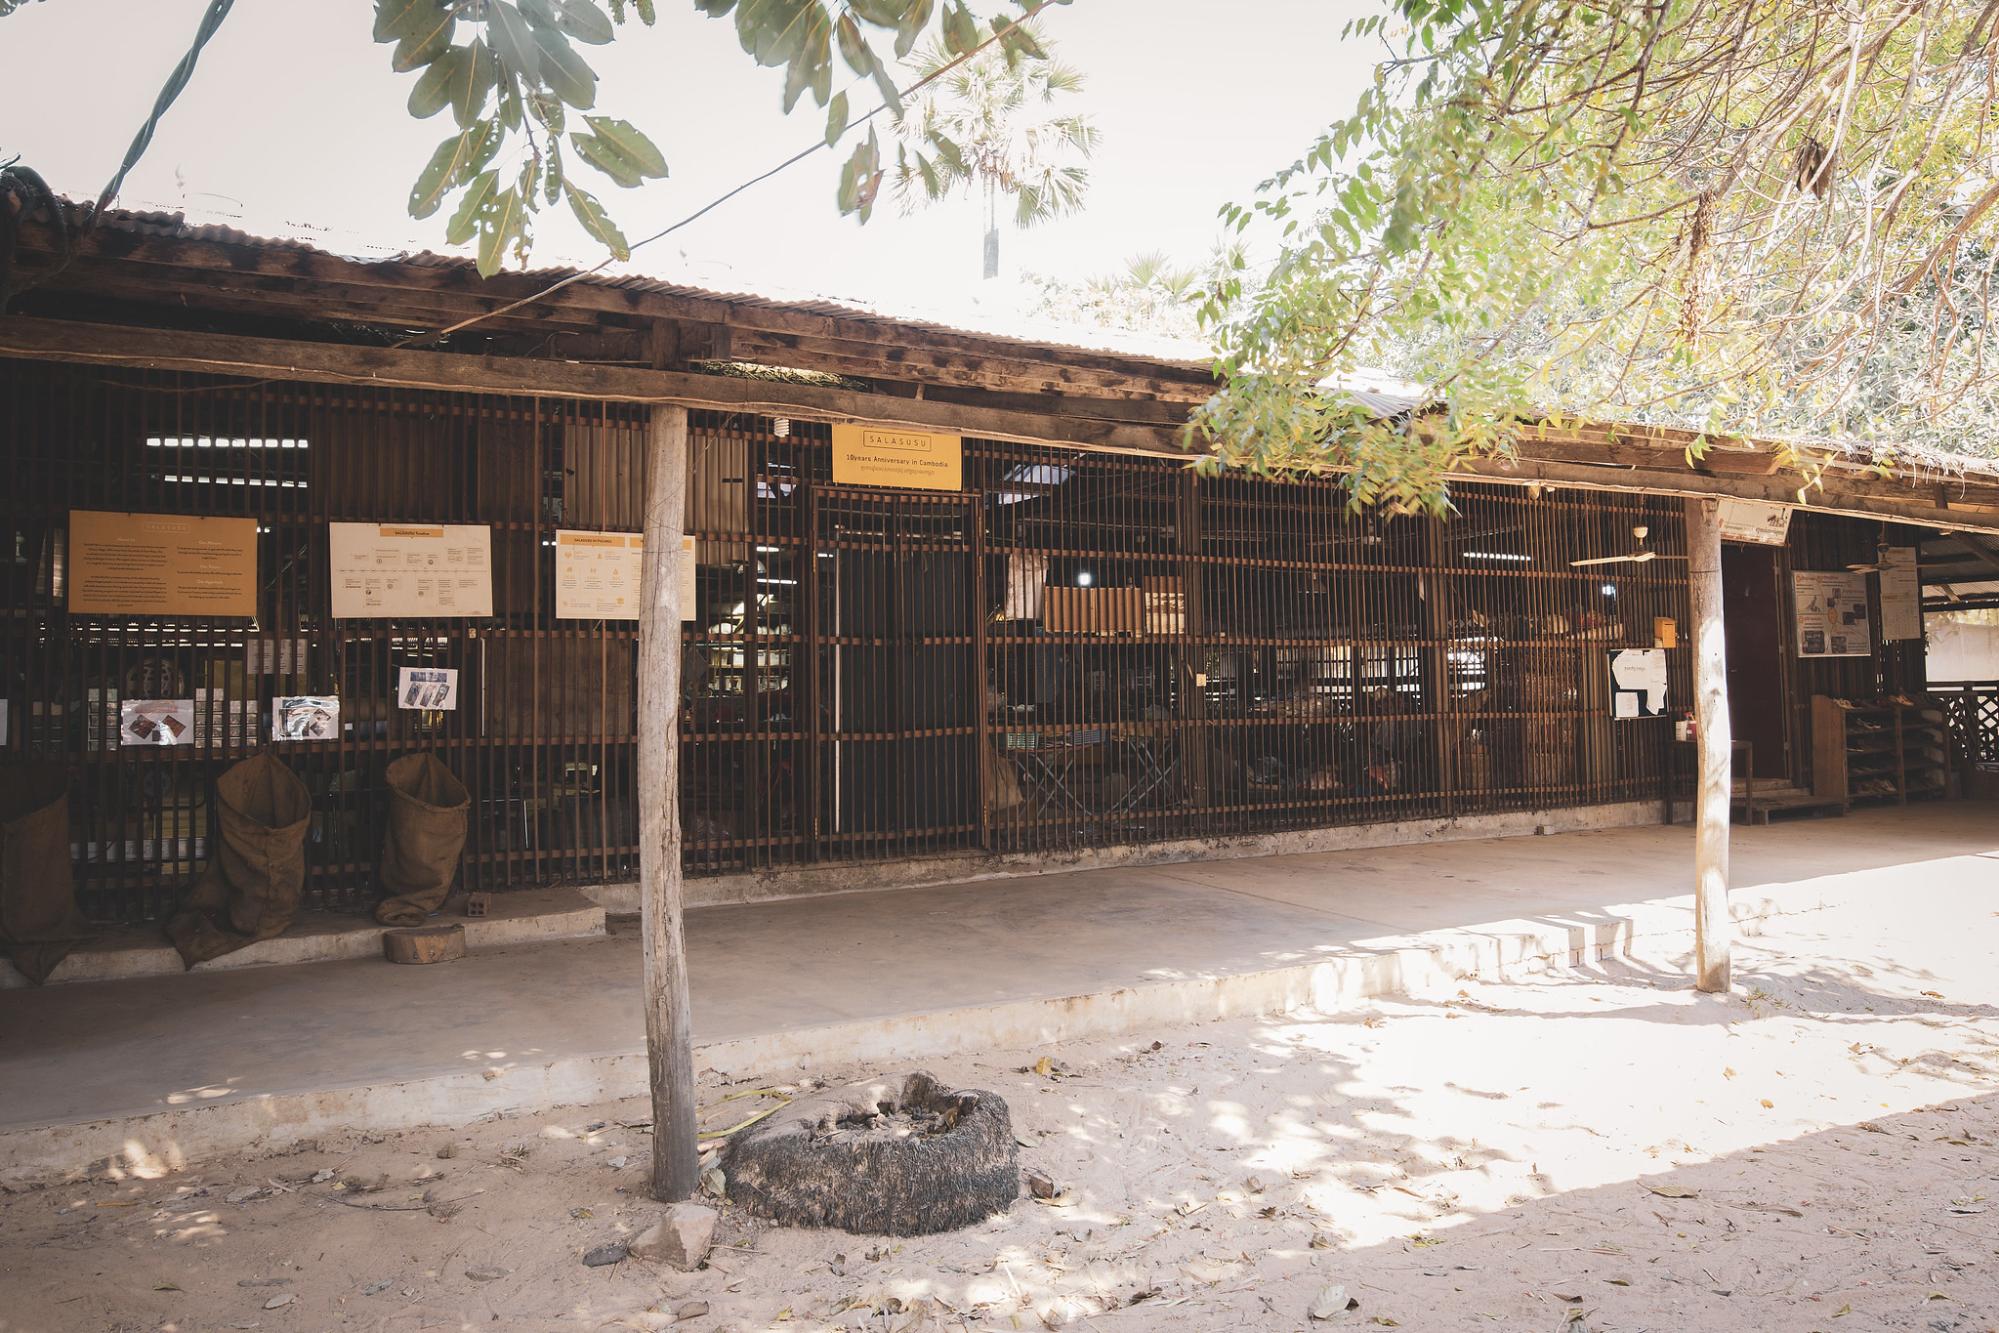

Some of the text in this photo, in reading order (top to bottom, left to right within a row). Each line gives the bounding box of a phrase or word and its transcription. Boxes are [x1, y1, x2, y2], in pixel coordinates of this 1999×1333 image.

[869, 436, 926, 447] SALASUSU
[873, 456, 910, 465] Anniversary
[919, 460, 948, 468] Cambodia
